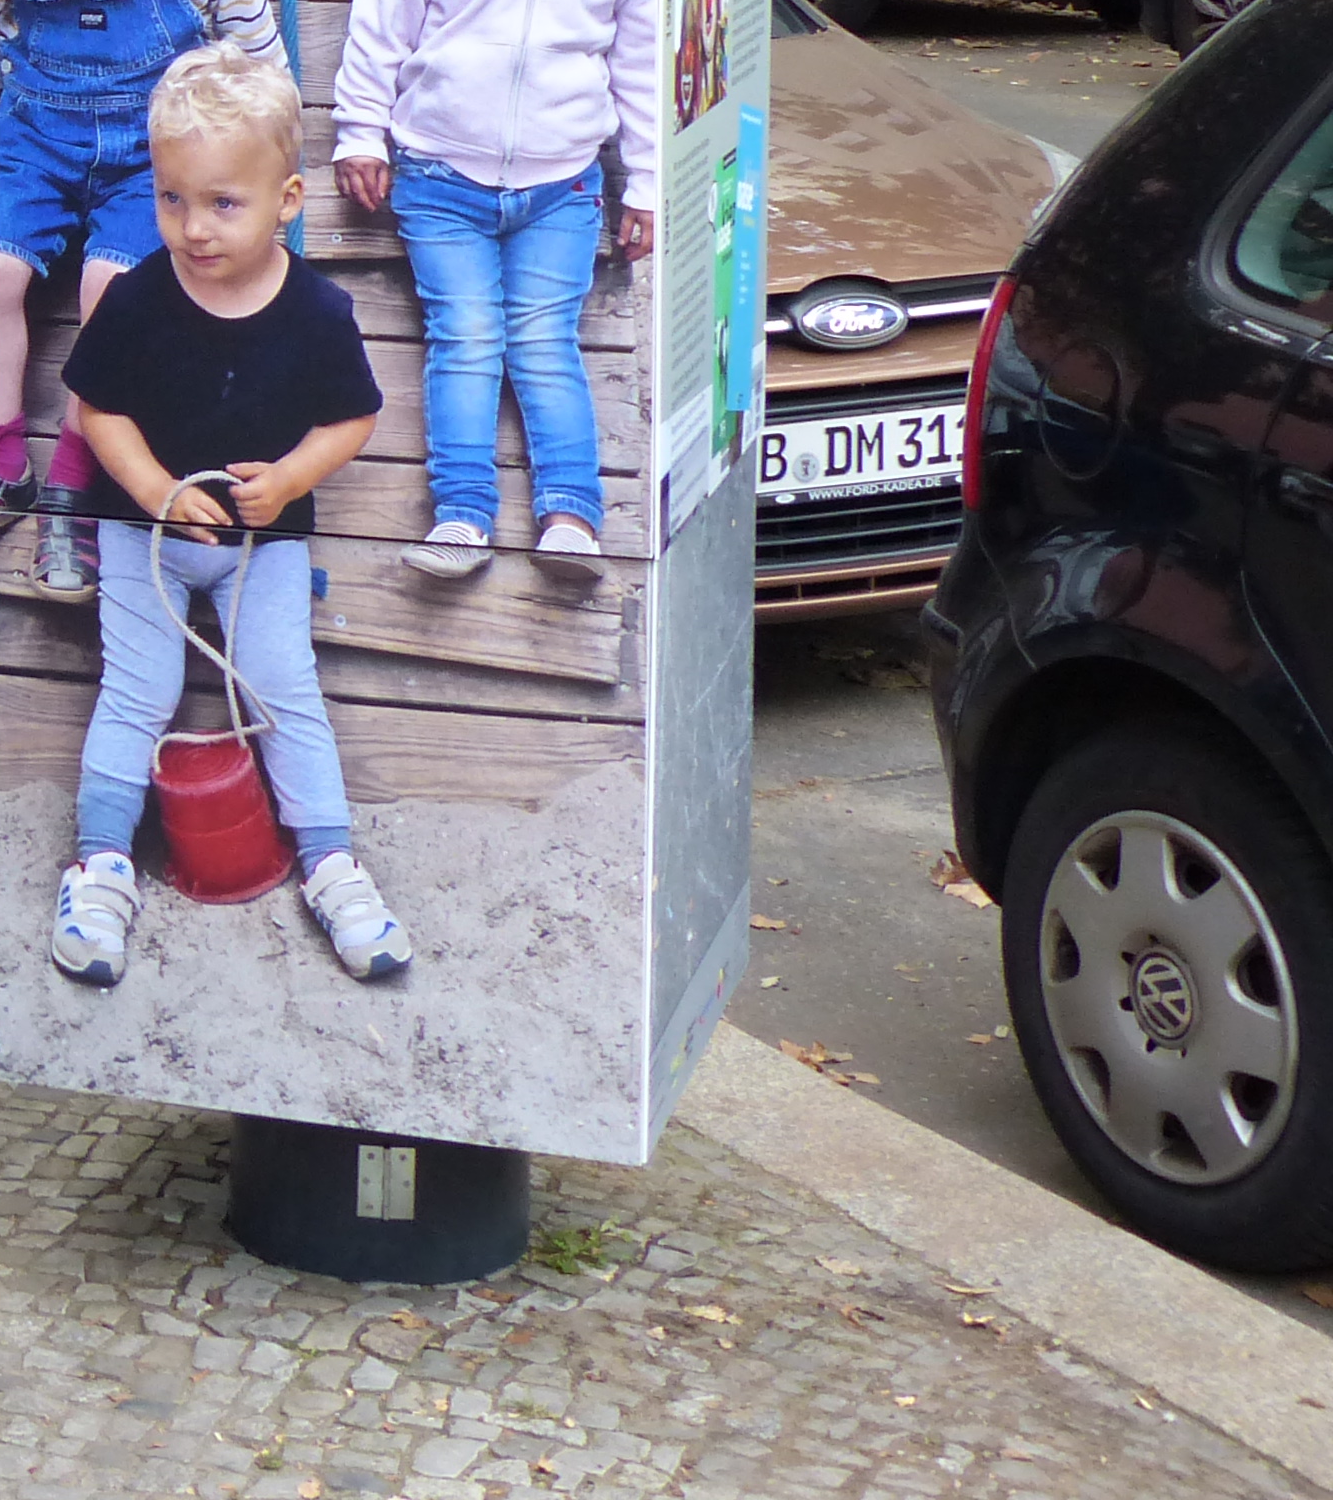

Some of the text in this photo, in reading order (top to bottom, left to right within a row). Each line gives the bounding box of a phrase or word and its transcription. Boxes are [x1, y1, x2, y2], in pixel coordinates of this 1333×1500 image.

[829, 304, 885, 333] Ford
[760, 431, 788, 484] B
[824, 421, 885, 477] DM
[808, 475, 943, 501] WWW.FORD-KADEA.DE
